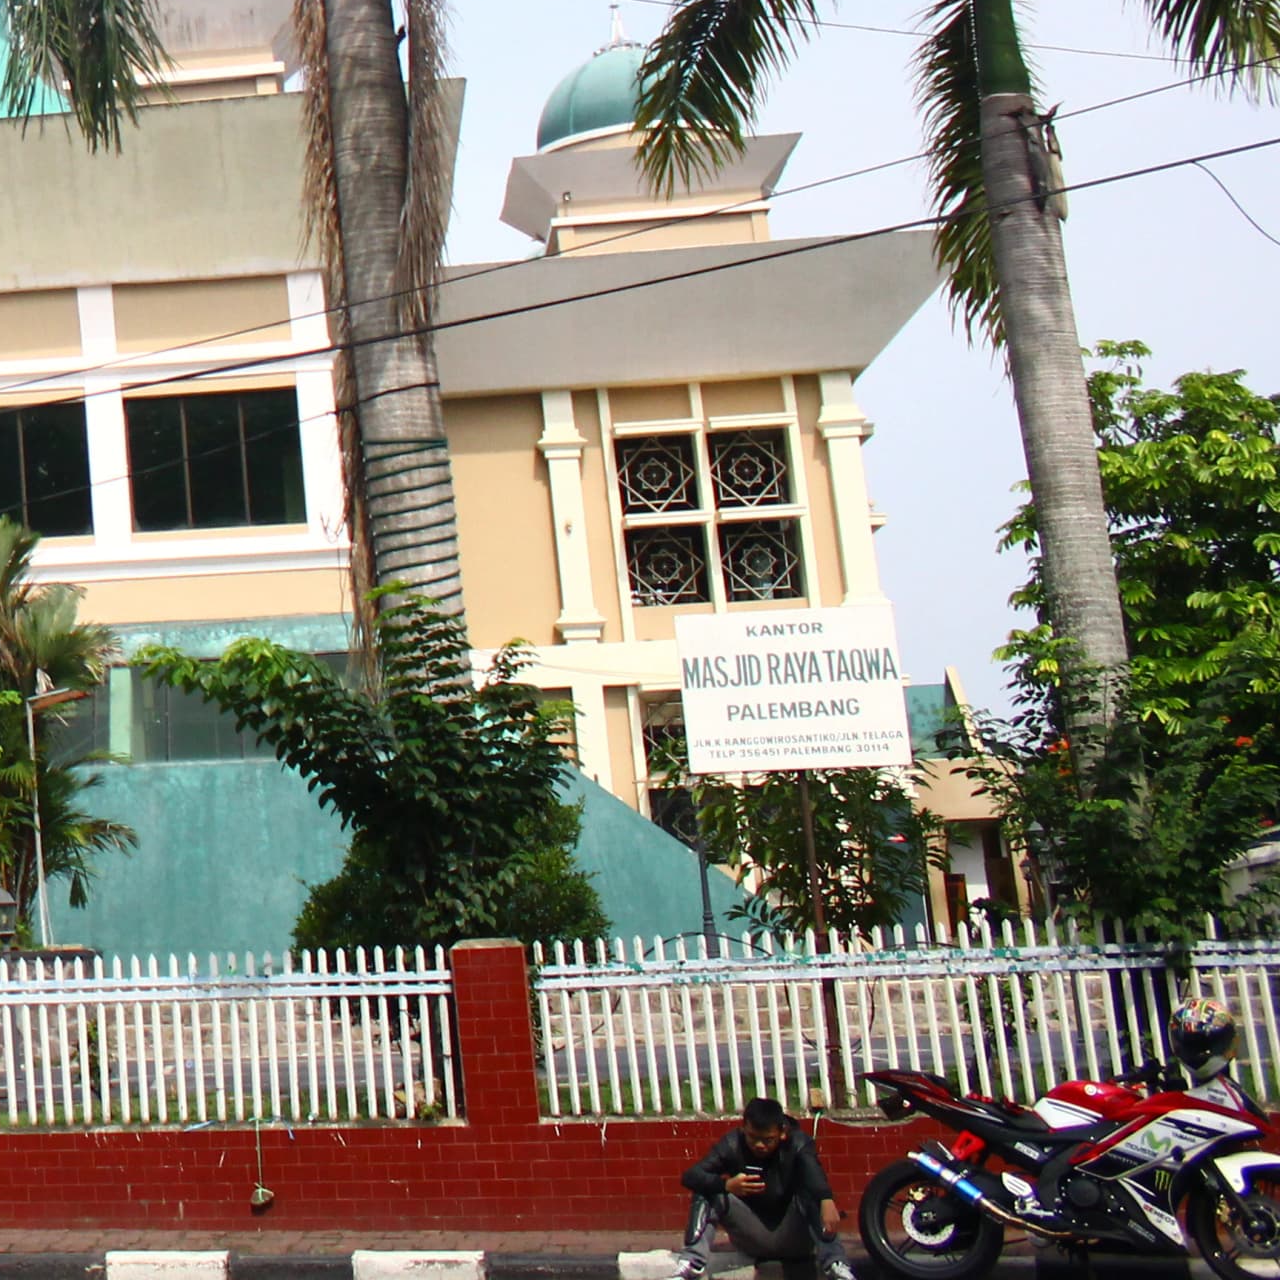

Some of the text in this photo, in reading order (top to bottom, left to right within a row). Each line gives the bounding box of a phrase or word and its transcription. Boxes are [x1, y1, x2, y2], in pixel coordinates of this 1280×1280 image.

[745, 622, 824, 637] KANTOR
[682, 647, 898, 689] MASJID RAYA TAQWA
[726, 697, 861, 721] PALEMBANG
[862, 730, 904, 740] TELAGA
[709, 750, 736, 759] TELP
[783, 744, 852, 756] PALEMBANG
